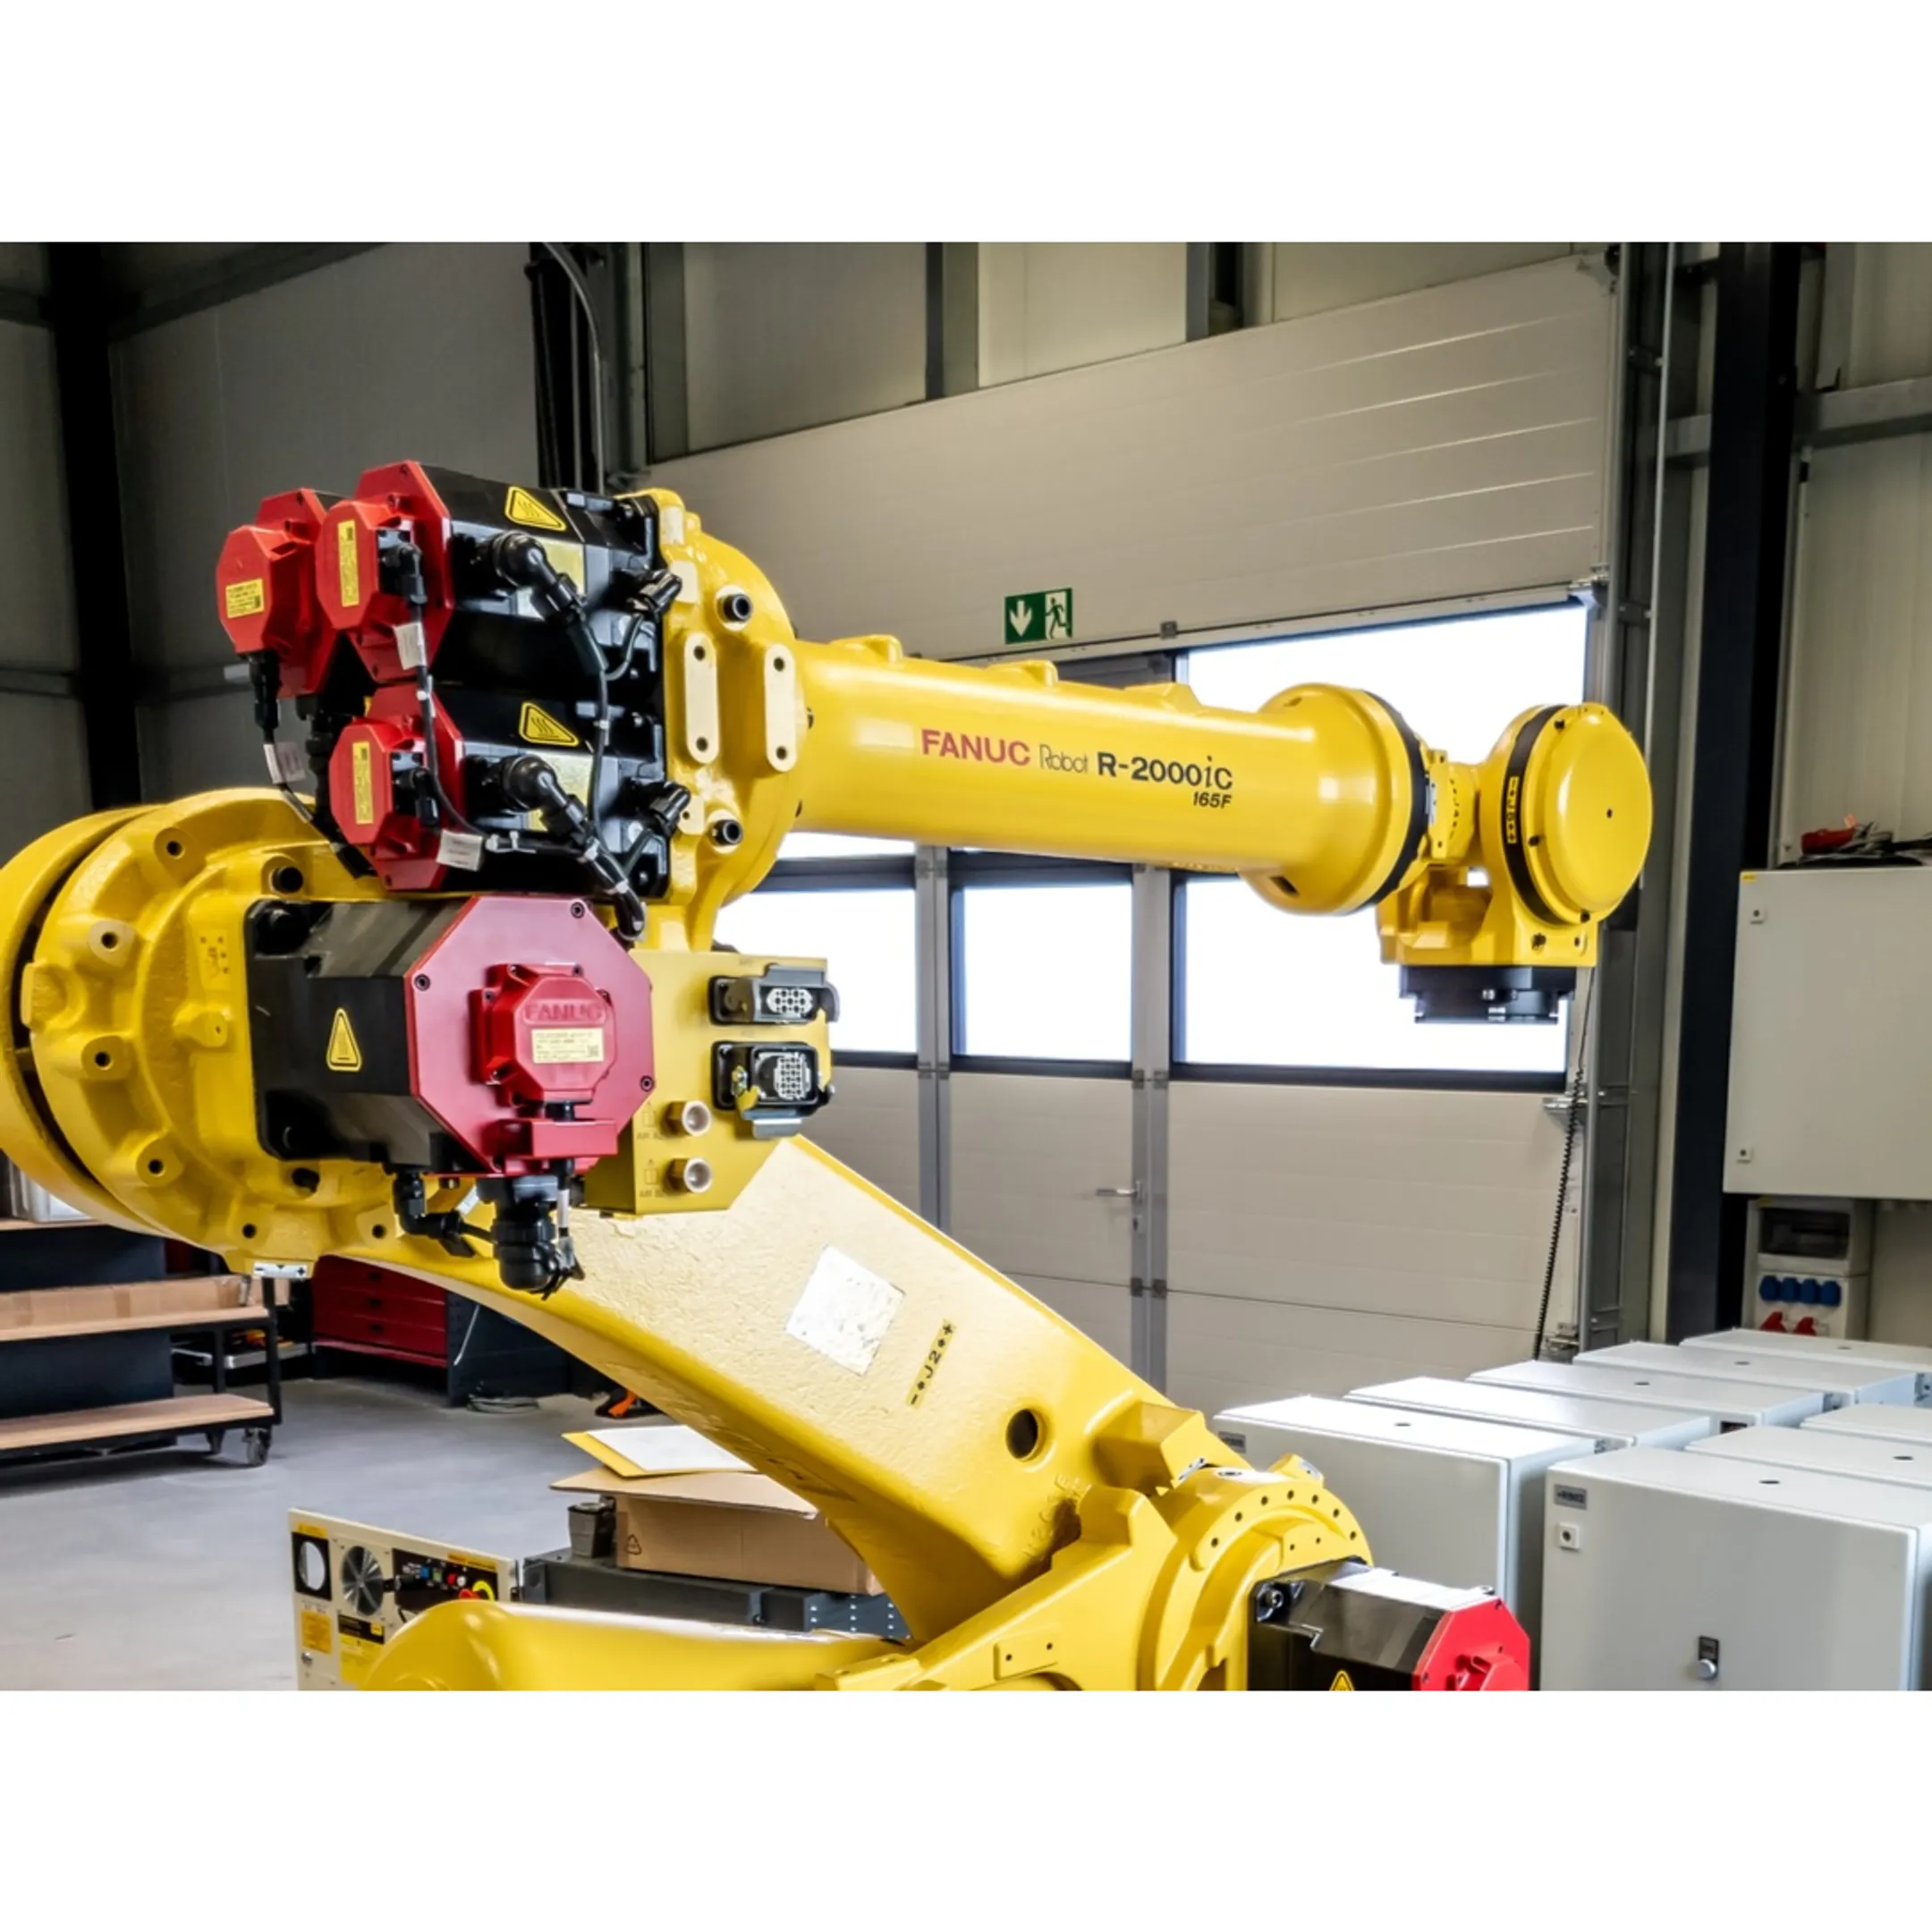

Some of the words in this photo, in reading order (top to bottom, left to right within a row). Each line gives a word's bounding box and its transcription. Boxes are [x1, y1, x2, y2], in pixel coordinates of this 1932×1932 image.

[921, 729, 1031, 767] FANUC
[1039, 744, 1089, 774] Robot
[1097, 751, 1233, 790] R-2000iC
[1193, 792, 1233, 809] 165F
[524, 1003, 604, 1021] FANUC
